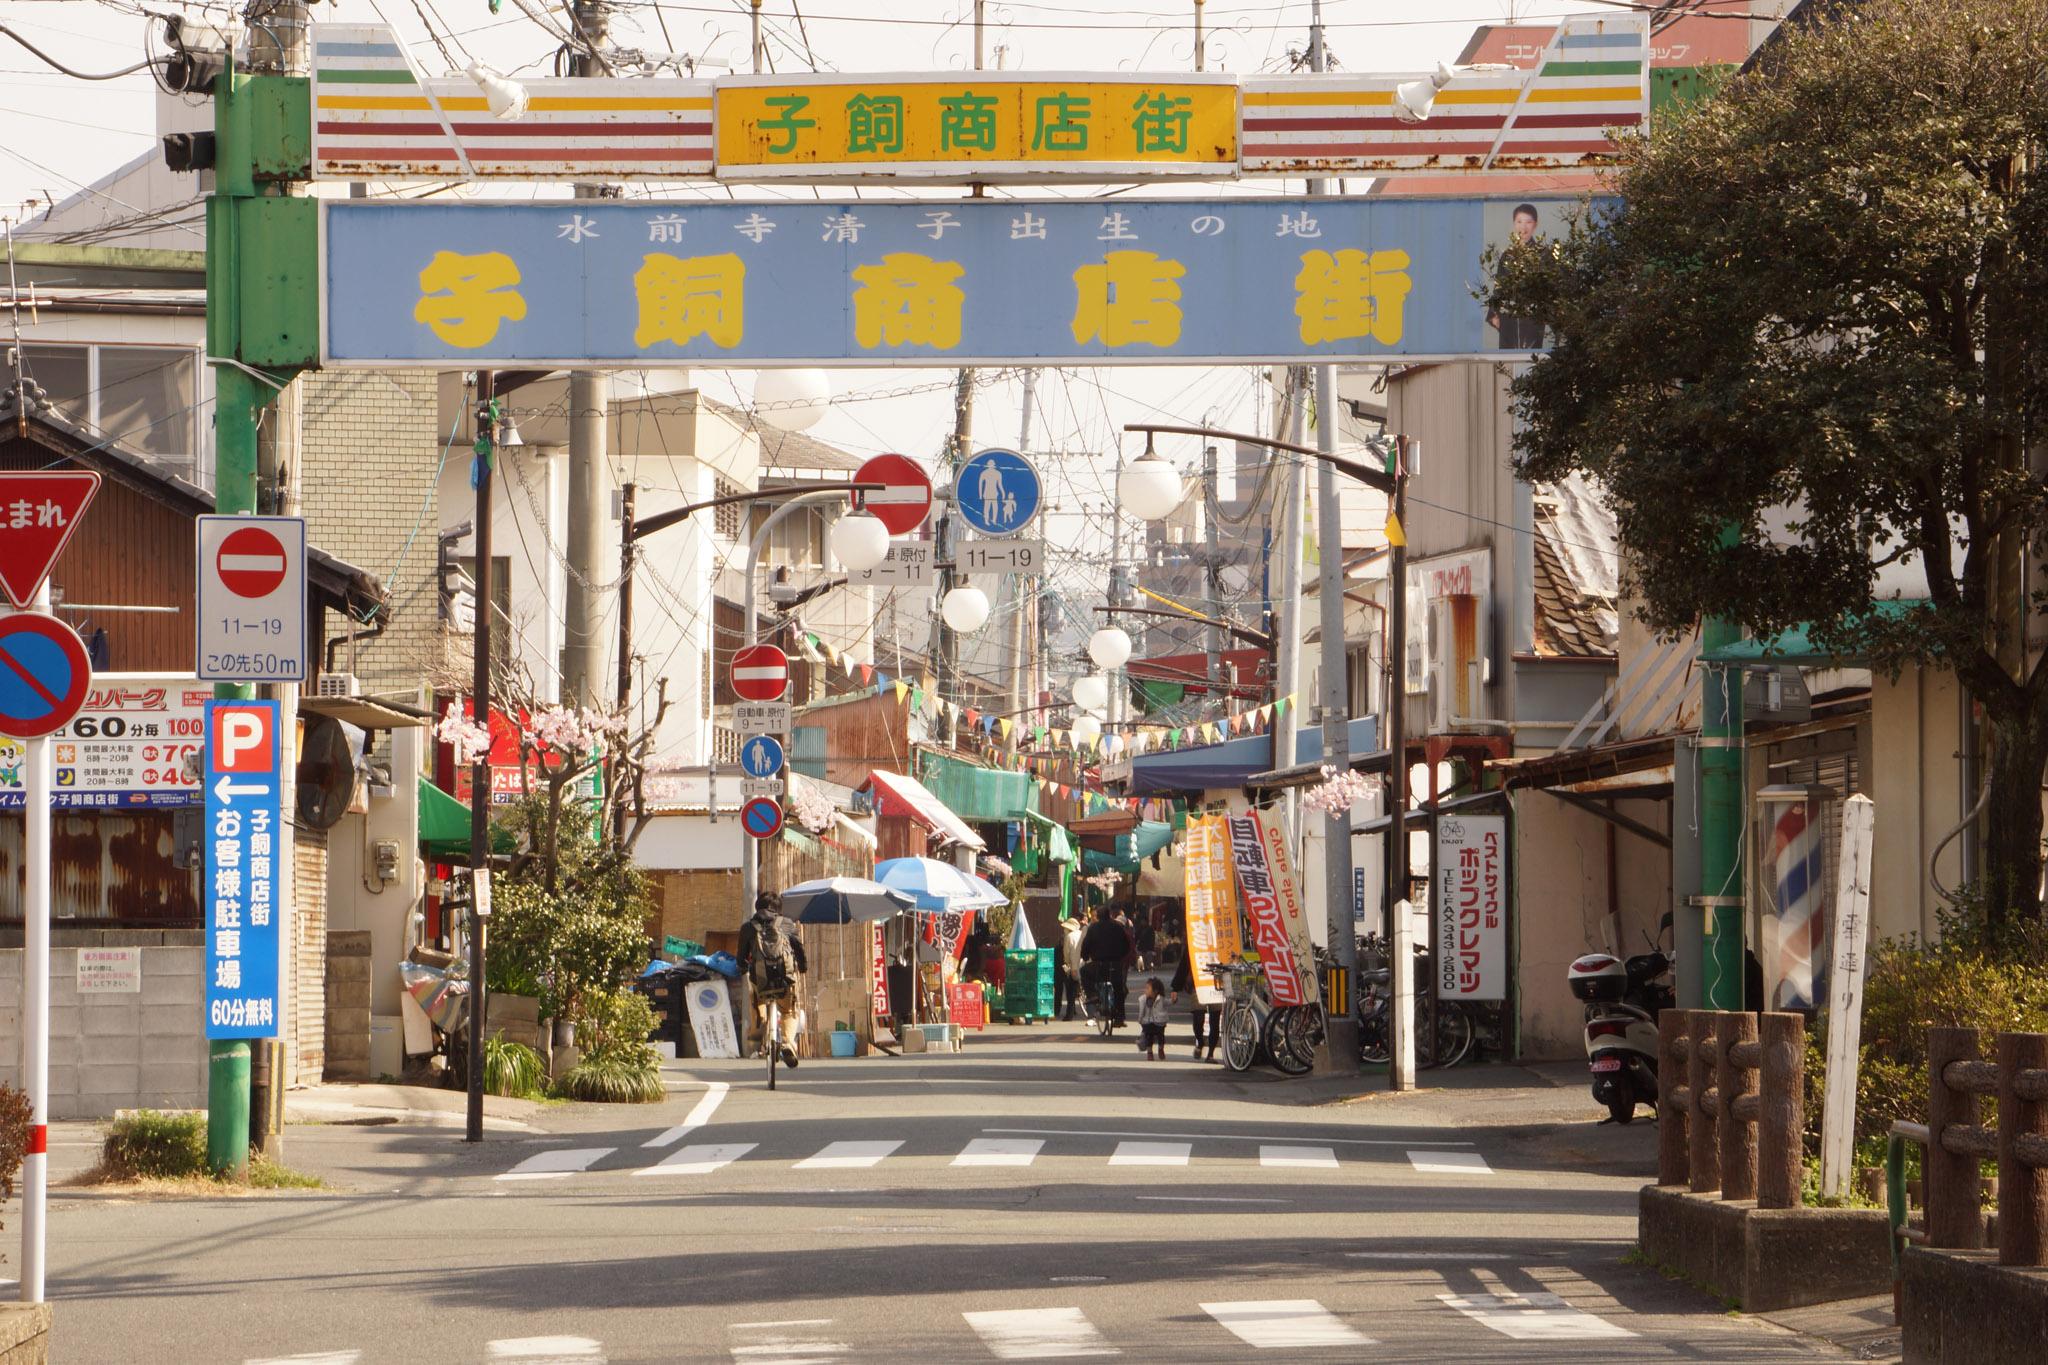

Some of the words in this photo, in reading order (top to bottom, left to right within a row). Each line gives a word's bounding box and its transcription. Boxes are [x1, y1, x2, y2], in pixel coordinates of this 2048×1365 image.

[757, 91, 1193, 155] 子飼商店街
[556, 211, 1323, 244] 水前寺清子出生の地
[412, 248, 1413, 349] 子飼商店街
[206, 653, 297, 675] この先50m
[222, 712, 264, 768] P
[215, 808, 242, 990] お客様駐車場
[250, 808, 271, 927] 子飼商店街
[1484, 831, 1498, 929] ベストサイクル
[1459, 846, 1480, 993] ポップクレマツ
[211, 998, 273, 1026] 60分無料
